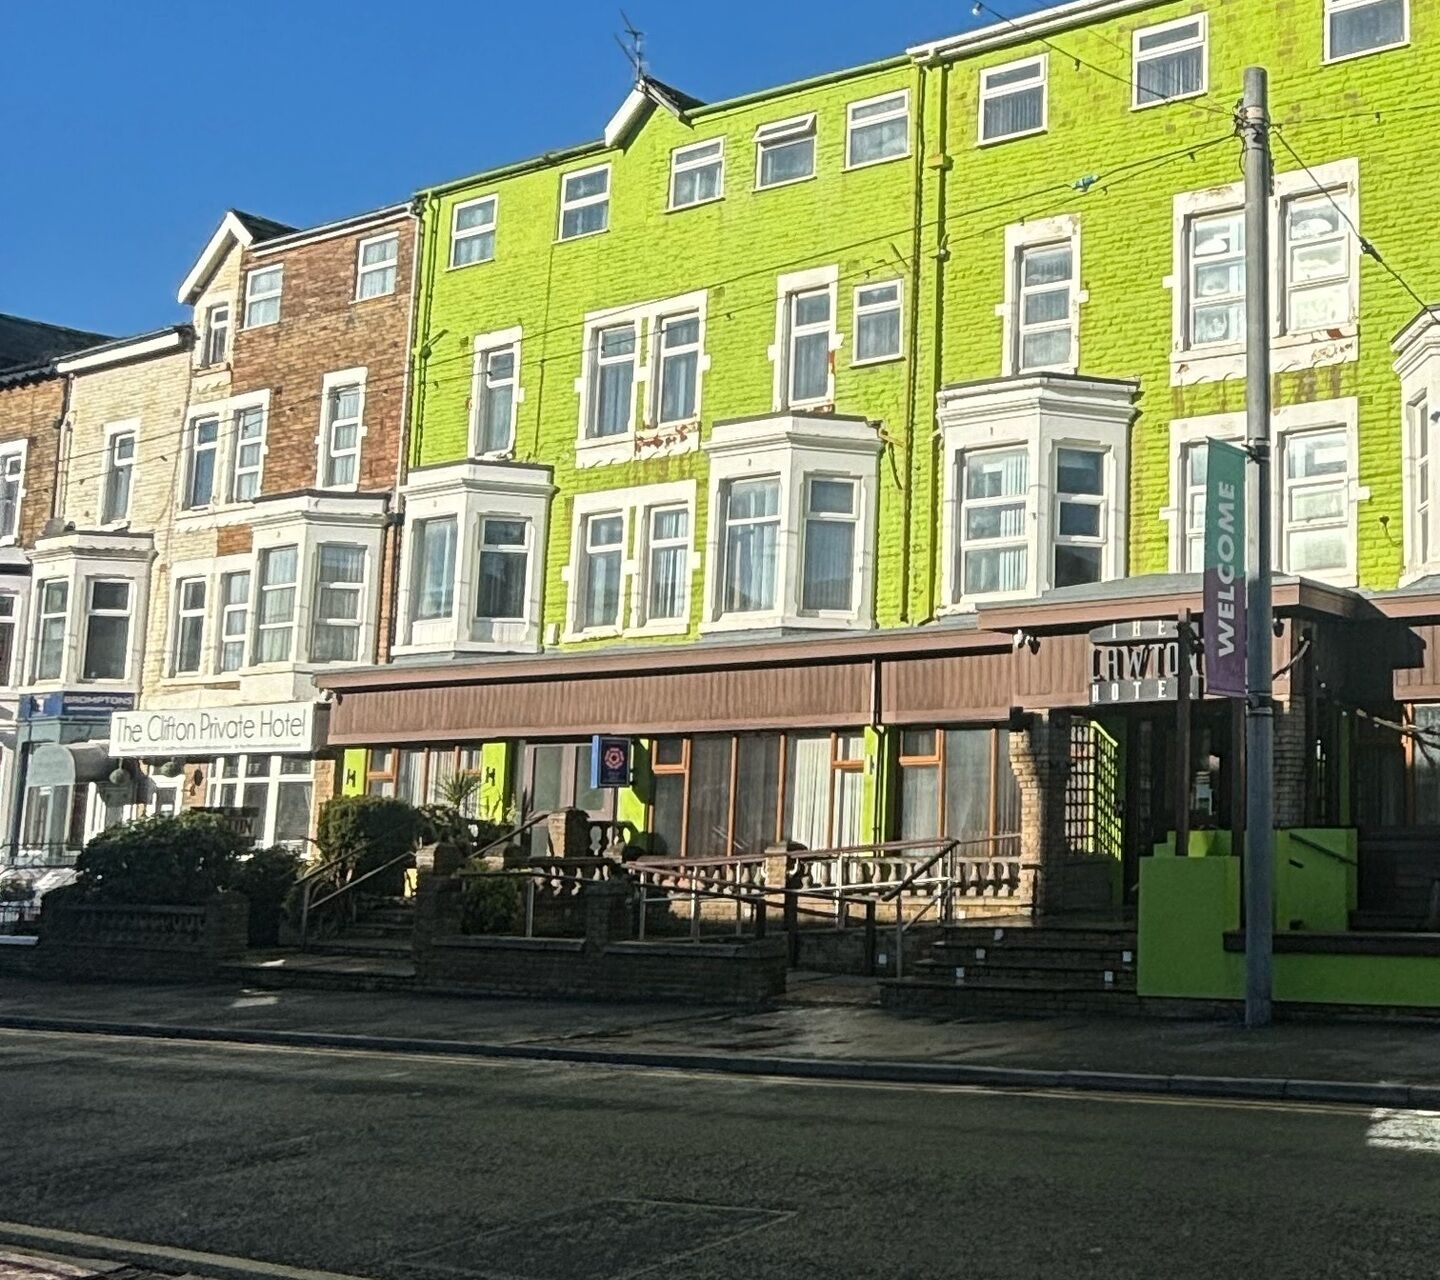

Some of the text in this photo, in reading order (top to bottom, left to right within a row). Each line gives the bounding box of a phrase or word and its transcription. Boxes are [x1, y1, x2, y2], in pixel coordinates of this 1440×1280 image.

[1217, 480, 1236, 658] WELCOME
[1112, 620, 1167, 639] THE
[64, 696, 133, 705] BROMPTONS
[1092, 680, 1194, 703] HOTE
[116, 708, 307, 743] The Clifton Private Hotel
